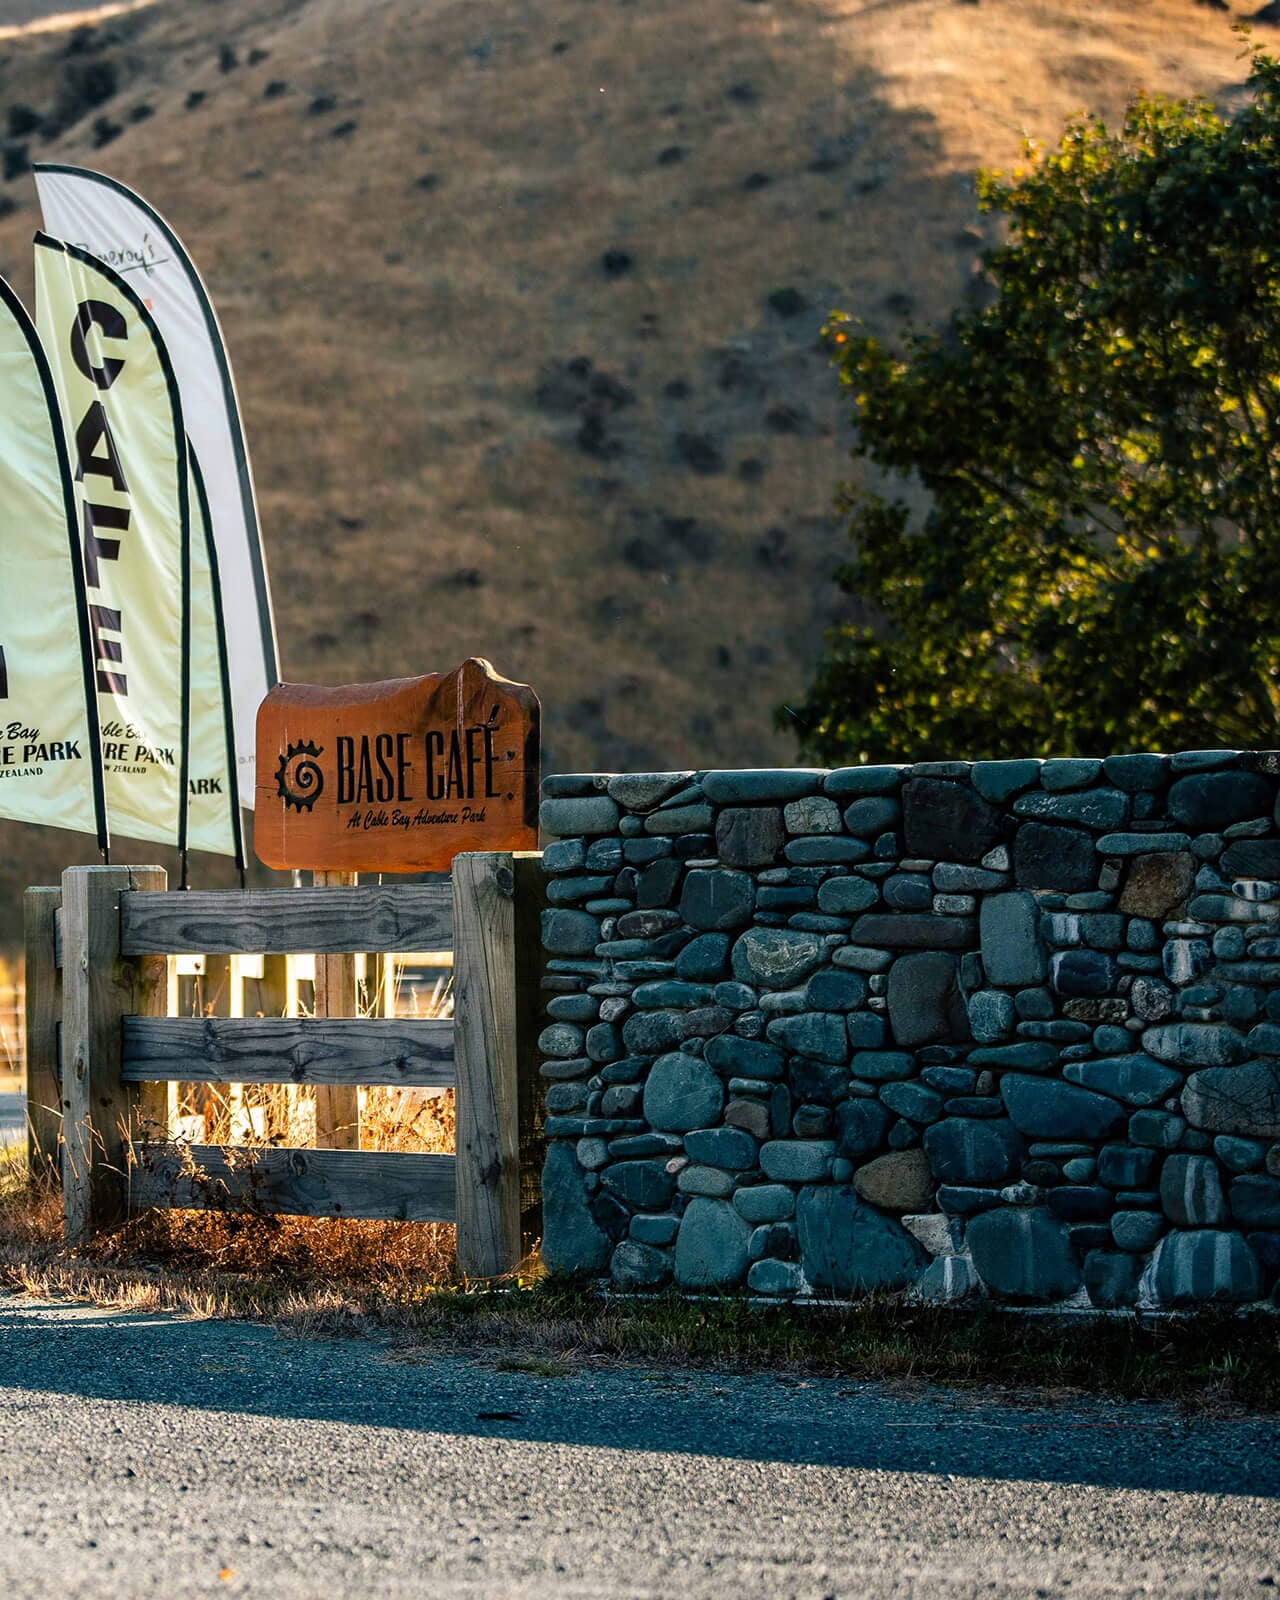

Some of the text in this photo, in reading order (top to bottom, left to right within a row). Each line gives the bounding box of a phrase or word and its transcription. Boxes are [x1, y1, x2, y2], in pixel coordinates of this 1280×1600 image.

[70, 299, 131, 698] CAFE
[6, 722, 41, 743] Bay
[23, 740, 82, 763] PARK
[336, 704, 501, 804] BASE CAFÉ
[0, 767, 43, 778] ZEALAND
[189, 777, 223, 796] ARK
[347, 806, 486, 831] At Cable Bay Adventure Park
